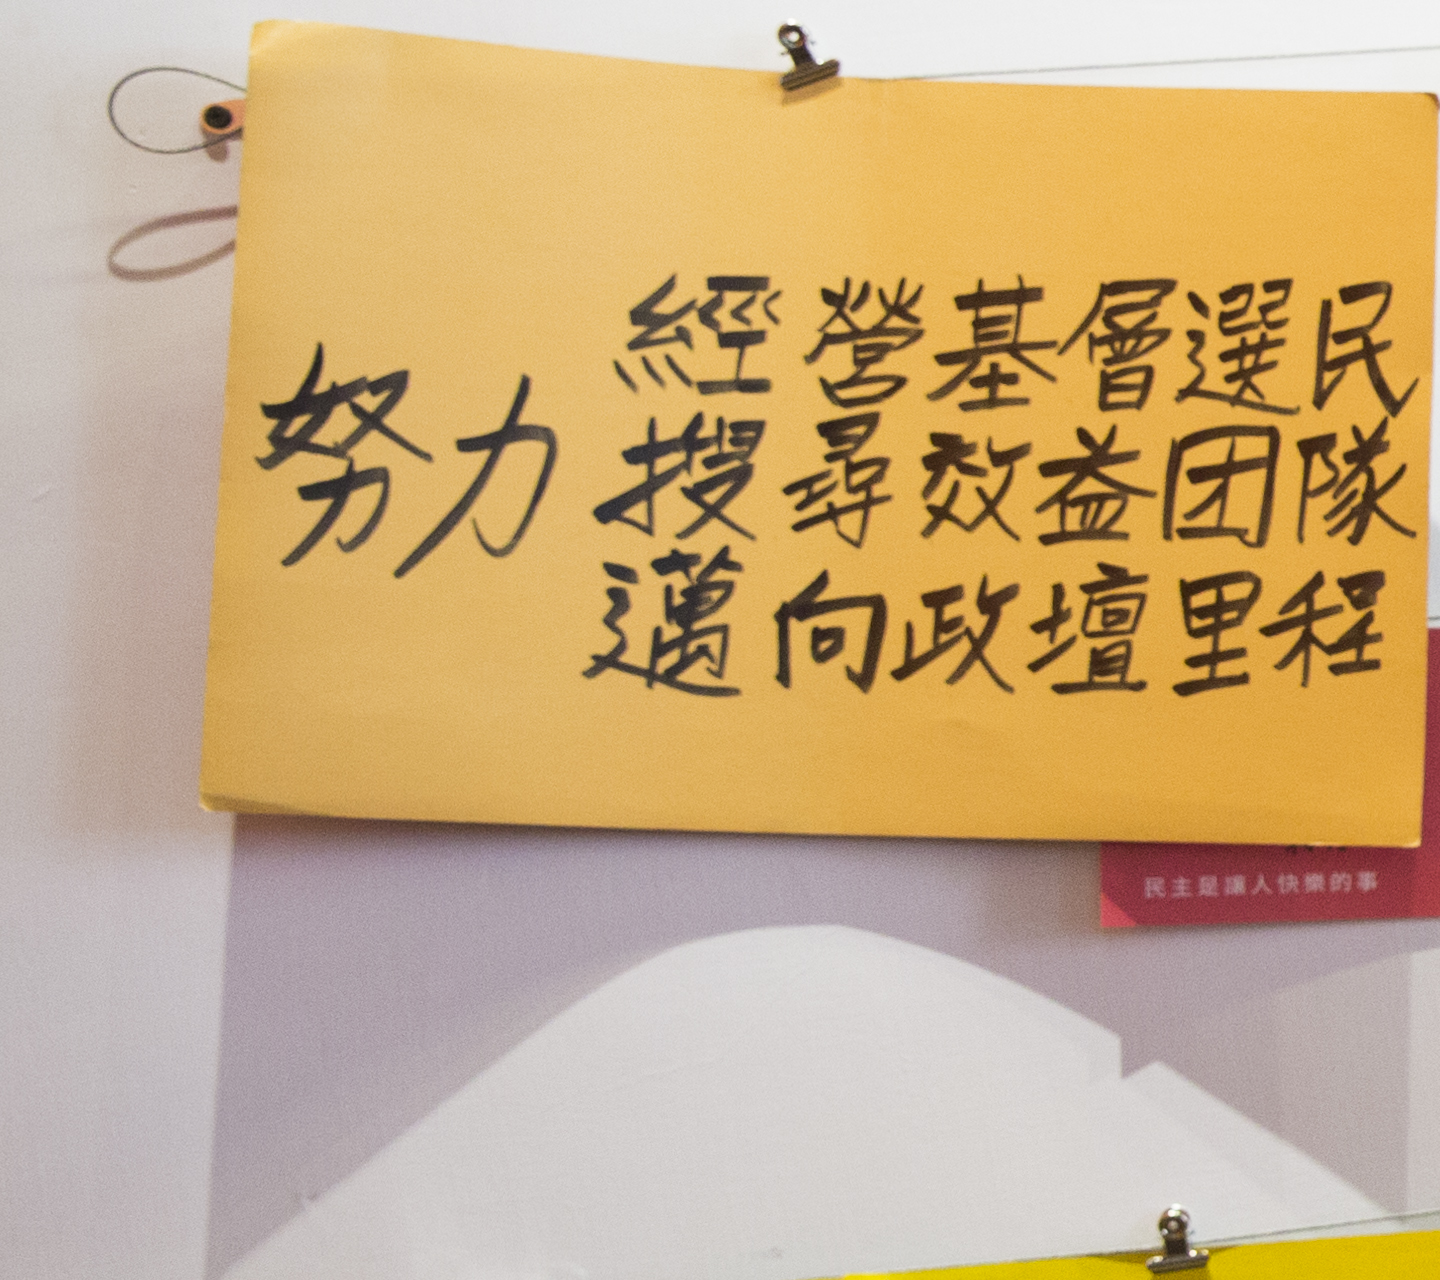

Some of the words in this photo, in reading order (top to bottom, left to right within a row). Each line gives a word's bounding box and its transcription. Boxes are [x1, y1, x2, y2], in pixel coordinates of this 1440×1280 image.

[613, 273, 1420, 418] 經營基層選民
[255, 341, 562, 578] 努力
[582, 547, 1388, 697] 邁向政壇里程
